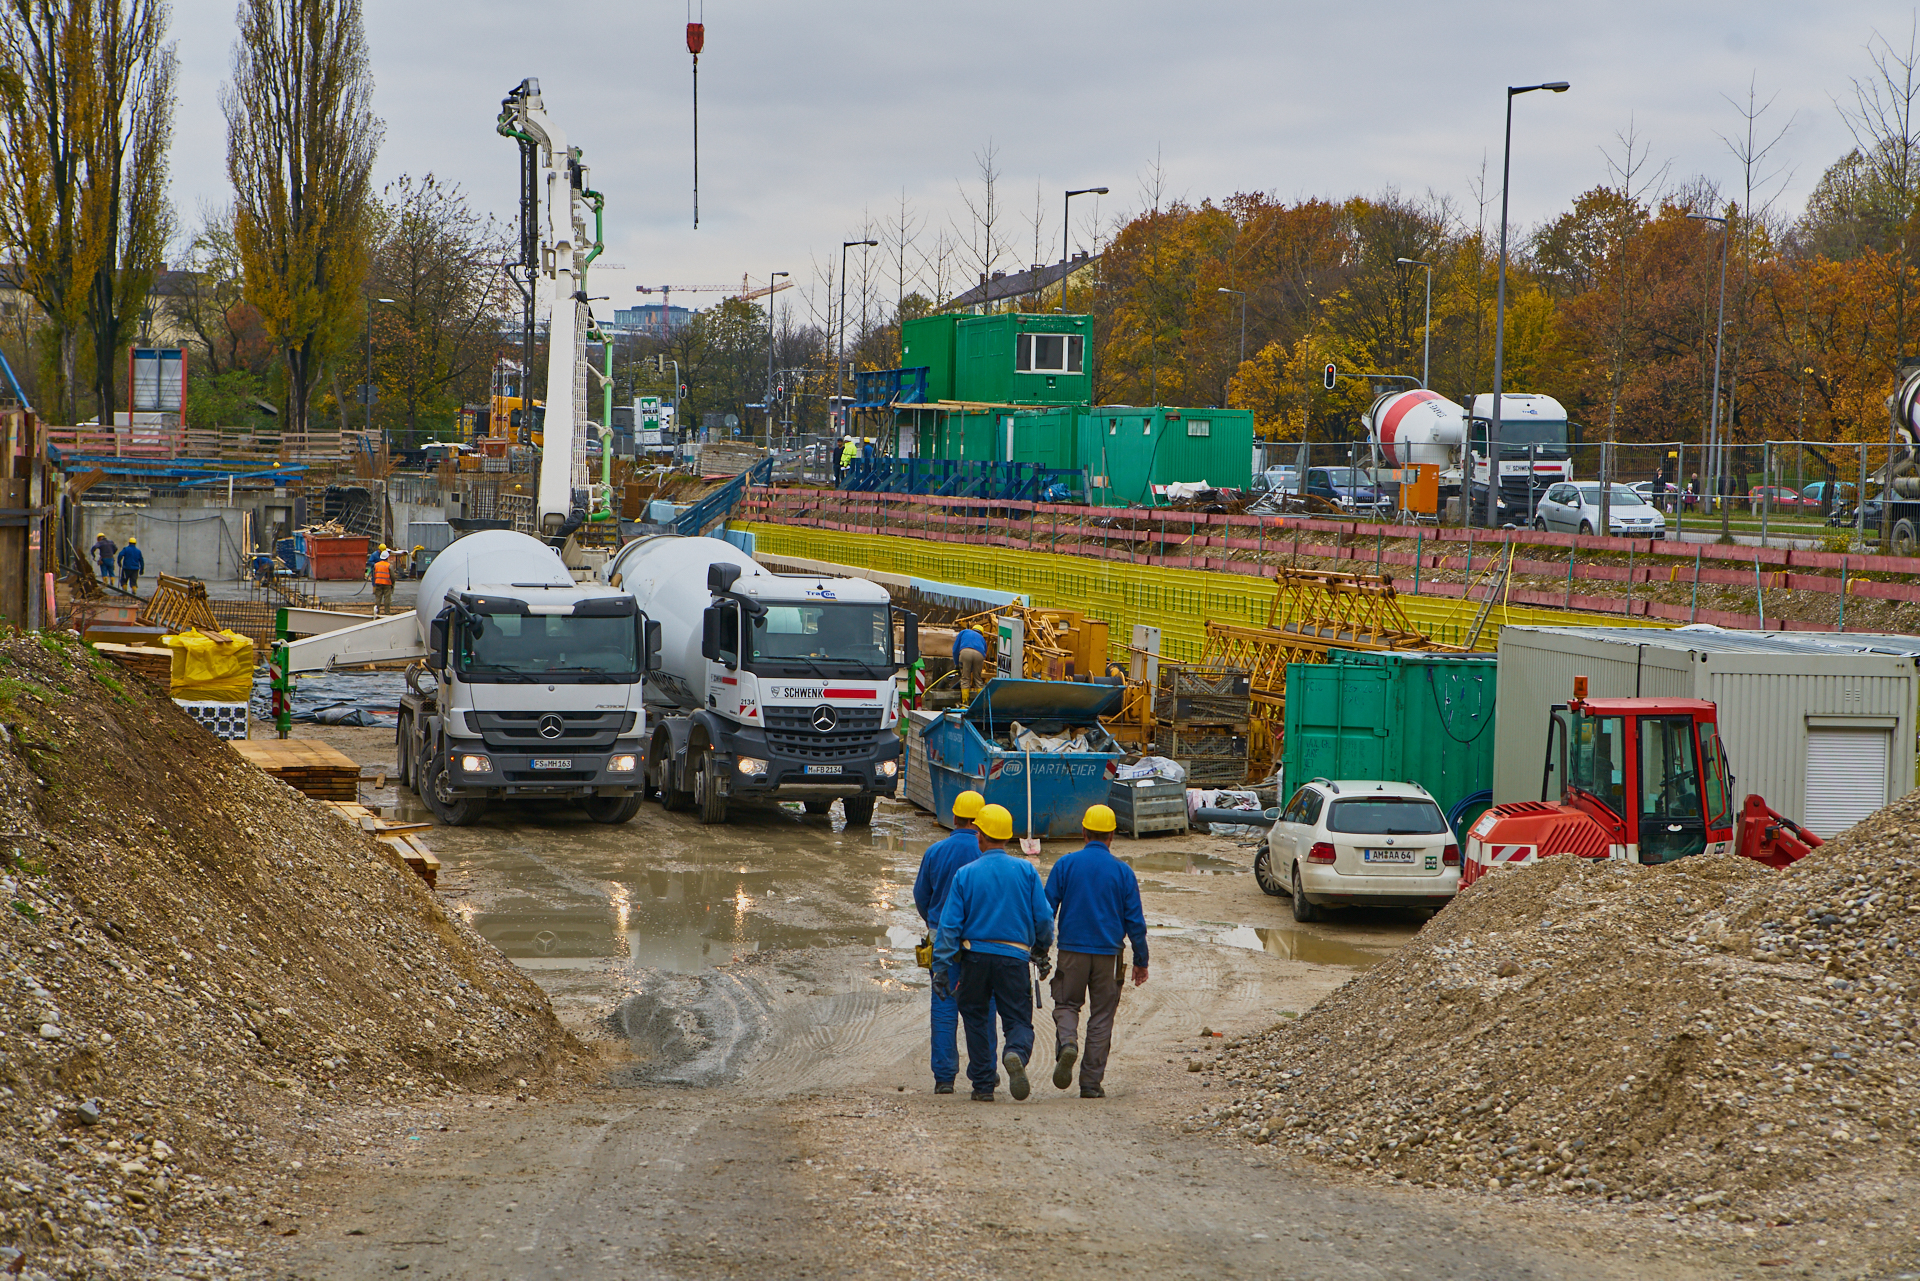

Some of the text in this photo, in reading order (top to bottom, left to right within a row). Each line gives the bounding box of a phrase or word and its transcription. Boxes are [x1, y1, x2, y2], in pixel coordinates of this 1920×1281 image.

[784, 687, 824, 698] SCHWENK
[1030, 763, 1097, 776] HARTMEIER
[1373, 851, 1411, 859] AM AA 64
